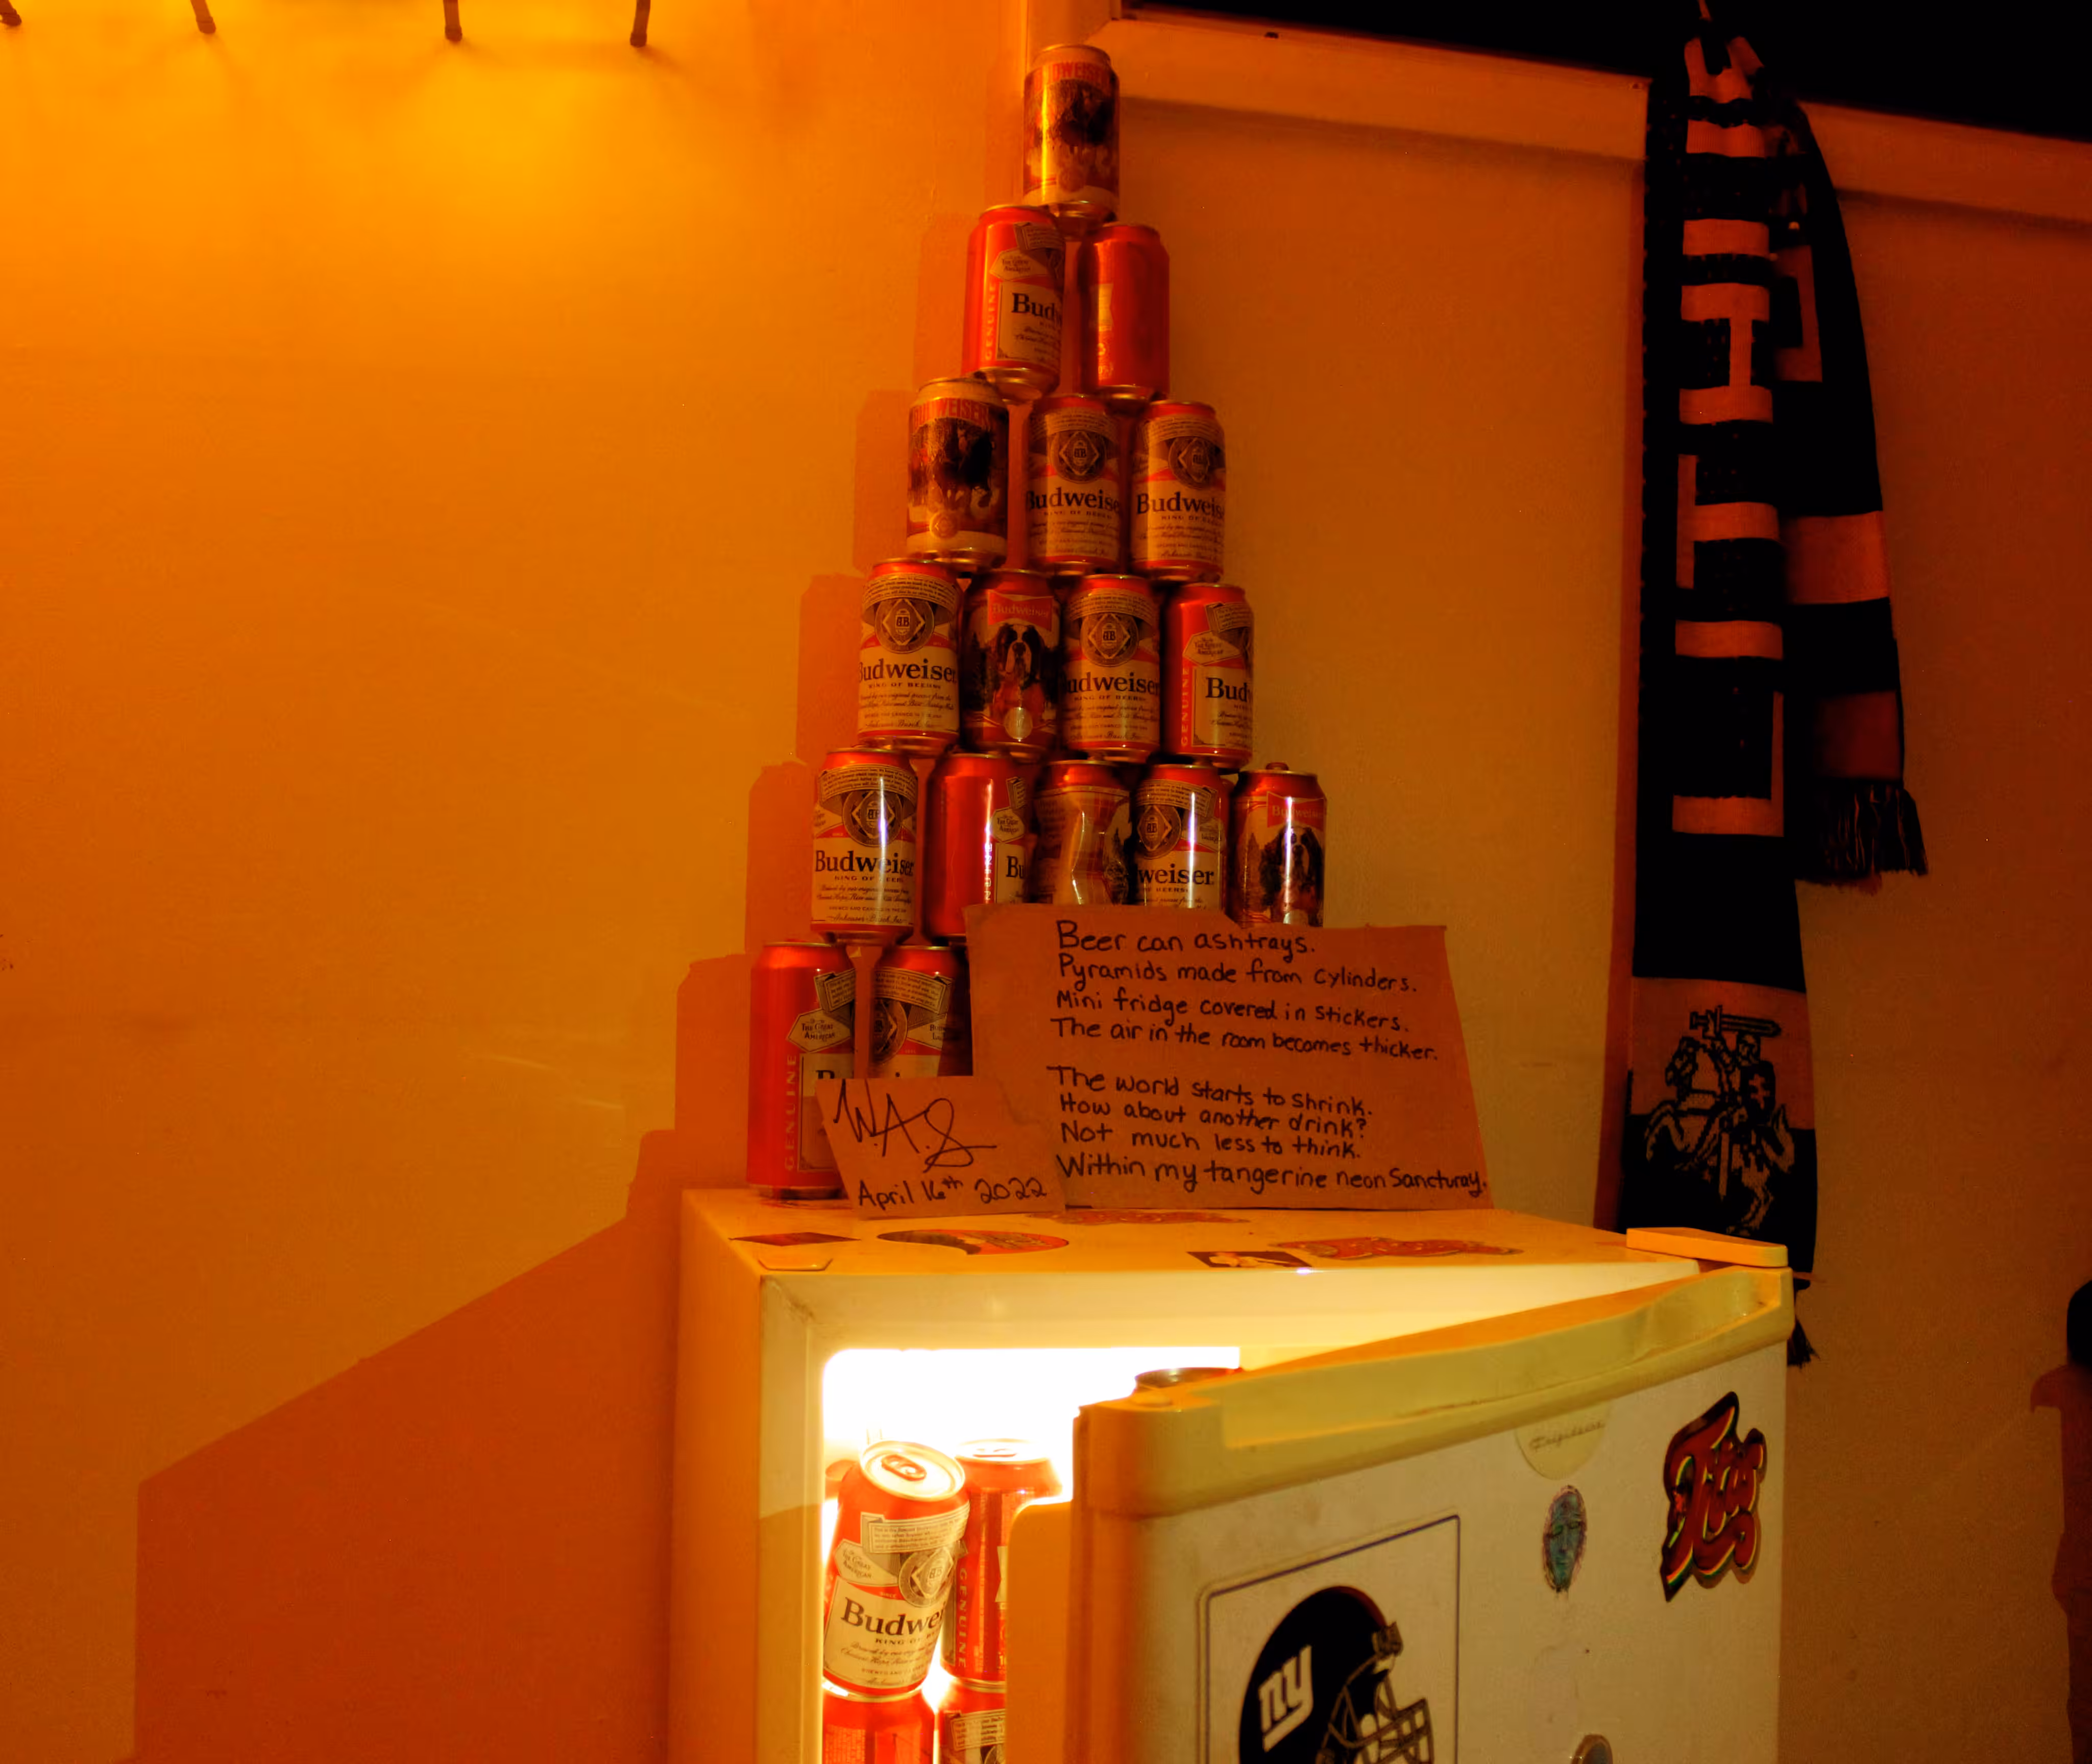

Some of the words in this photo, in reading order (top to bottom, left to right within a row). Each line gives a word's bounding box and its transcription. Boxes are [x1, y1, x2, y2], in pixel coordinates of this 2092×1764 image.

[985, 281, 998, 361] GENUINE
[1181, 667, 1190, 746] GENUINE
[1005, 855, 1025, 878] Bu
[1138, 863, 1214, 886] weiser
[1055, 918, 1127, 951] Beer
[1136, 935, 1184, 951] can
[1194, 933, 1316, 964] ashtrays.
[1058, 952, 1168, 992] Pyramids
[1177, 963, 1238, 983] made
[1246, 957, 1302, 984] from
[1056, 989, 1104, 1011] Mini
[1112, 986, 1189, 1027] fridge
[1200, 998, 1278, 1020] covered
[1284, 1002, 1307, 1022] in
[1050, 1016, 1103, 1038] The
[1110, 1018, 1144, 1041] air
[1149, 1023, 1169, 1042] in
[1174, 1022, 1211, 1045] the
[1222, 1032, 1266, 1049] room
[1272, 1032, 1352, 1057] becomes
[1358, 1036, 1439, 1061] thicker.
[1045, 1064, 1107, 1092] The
[1115, 1075, 1180, 1097] world
[1190, 1080, 1255, 1106] starts
[1262, 1086, 1286, 1107] to
[784, 1054, 796, 1172] GENUINE
[1060, 1092, 1111, 1116] How
[1123, 1100, 1187, 1123] about
[1199, 1108, 1280, 1130] another
[1287, 1112, 1368, 1140] drink?
[1060, 1119, 1114, 1143] Not
[1131, 1131, 1201, 1150] much
[1214, 1133, 1256, 1153] less
[1261, 1135, 1283, 1155] to
[1292, 1134, 1363, 1160] think.
[858, 1180, 915, 1211] April
[919, 1175, 964, 1202] 16th
[973, 1176, 1048, 1205] 2022
[1055, 1151, 1146, 1179] Within
[1155, 1161, 1199, 1193] my
[1203, 1159, 1328, 1195] tangerine
[1335, 1168, 1388, 1189] neon
[958, 1567, 968, 1669] GENUINE
